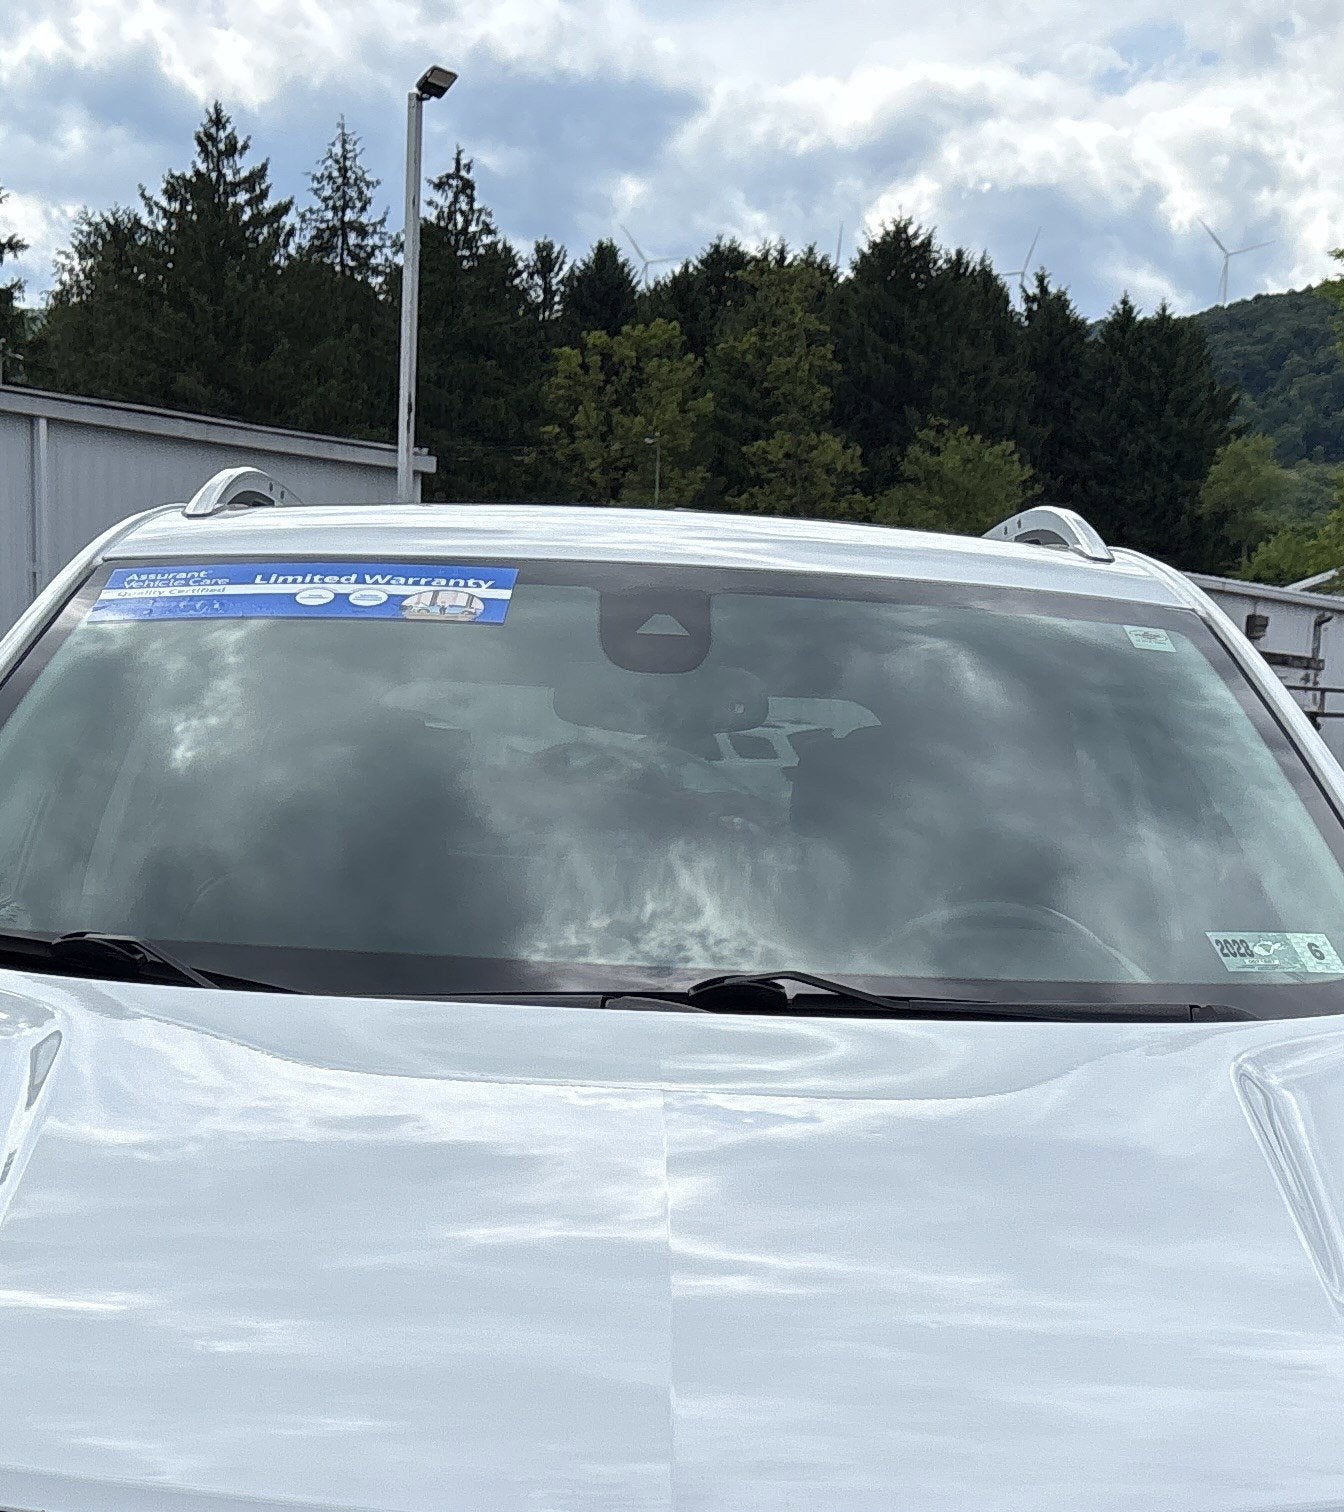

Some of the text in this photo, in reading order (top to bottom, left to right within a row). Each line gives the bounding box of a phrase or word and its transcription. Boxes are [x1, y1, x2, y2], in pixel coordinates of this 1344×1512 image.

[255, 574, 495, 589] Limited Warranty
[1306, 942, 1325, 960] 6
